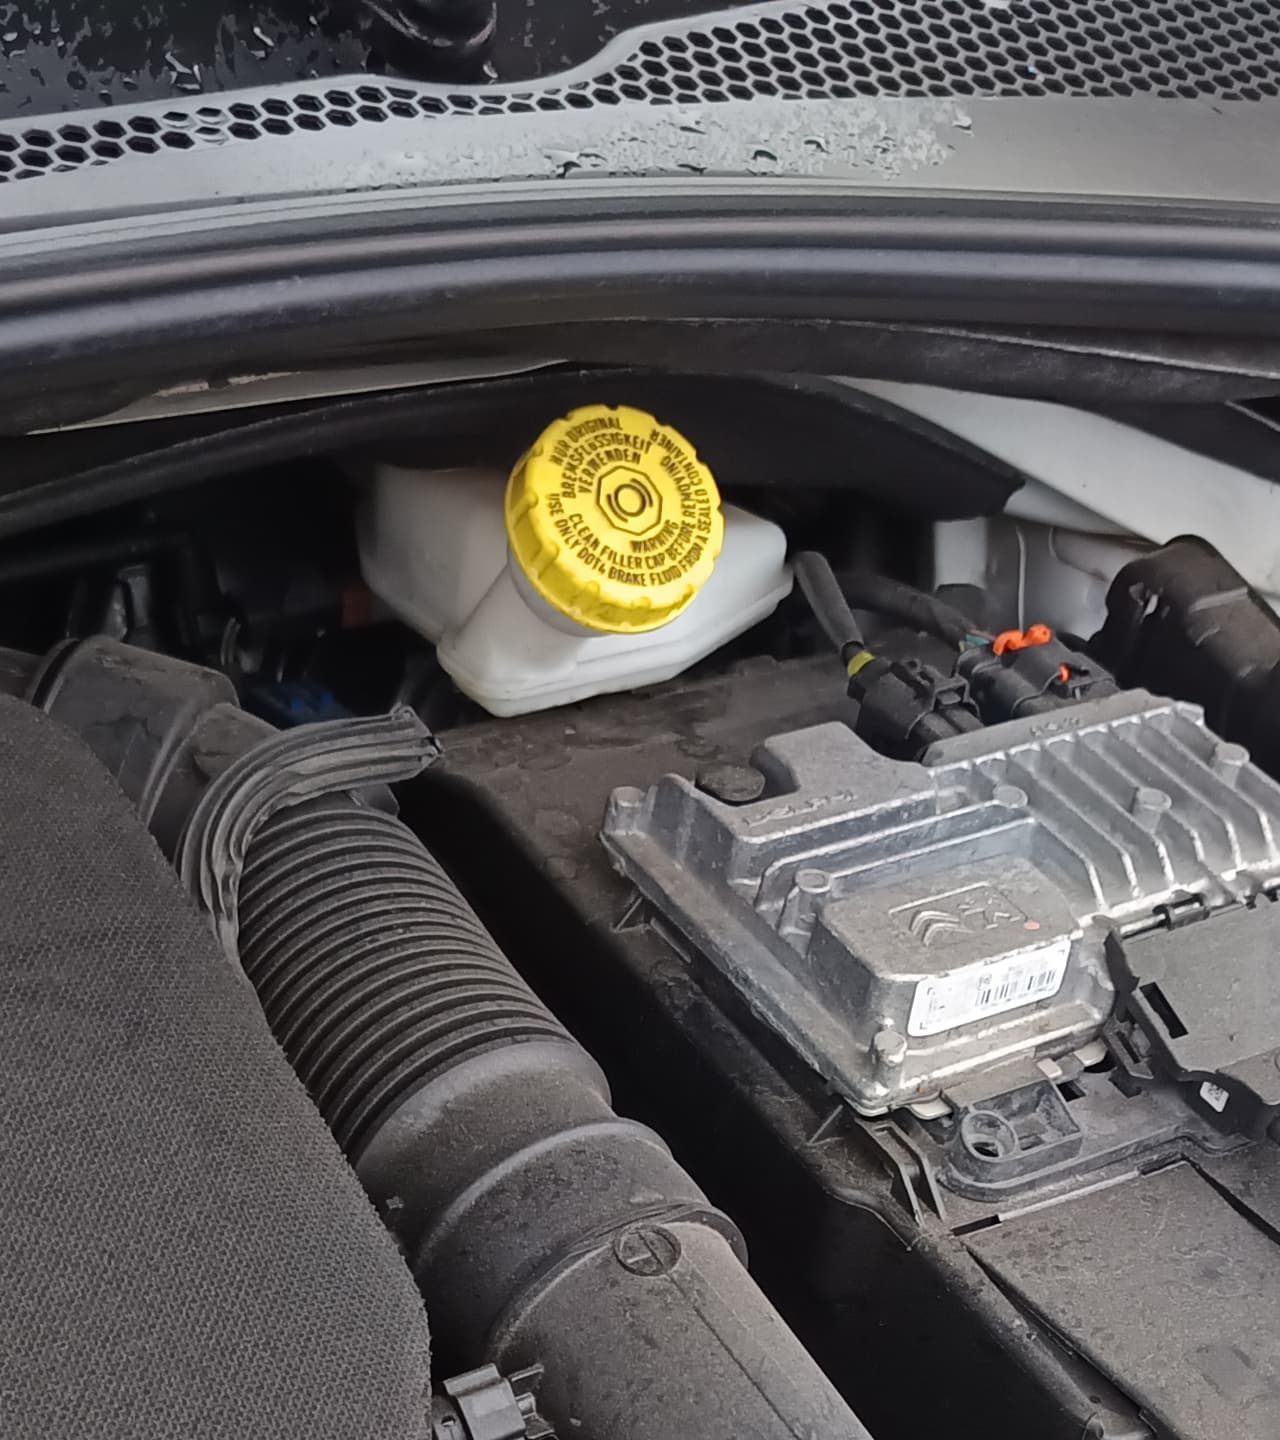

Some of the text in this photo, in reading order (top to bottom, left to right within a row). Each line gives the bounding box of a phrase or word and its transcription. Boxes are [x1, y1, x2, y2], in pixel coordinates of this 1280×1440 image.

[549, 417, 623, 466] NUR ORIGINAL
[650, 429, 703, 486] CONTAINER
[578, 448, 641, 493] VERWENDEN
[546, 493, 564, 516] USE
[569, 455, 696, 569] CLEAN FILLER CAP BEFORE REMOVING
[694, 488, 712, 533] SEALED
[554, 519, 582, 549] ONLY
[630, 520, 679, 553] WARNING
[577, 546, 606, 574] DOT4
[678, 542, 704, 573] FROM
[608, 566, 647, 587] BRAKE
[649, 565, 682, 586] FLUID
